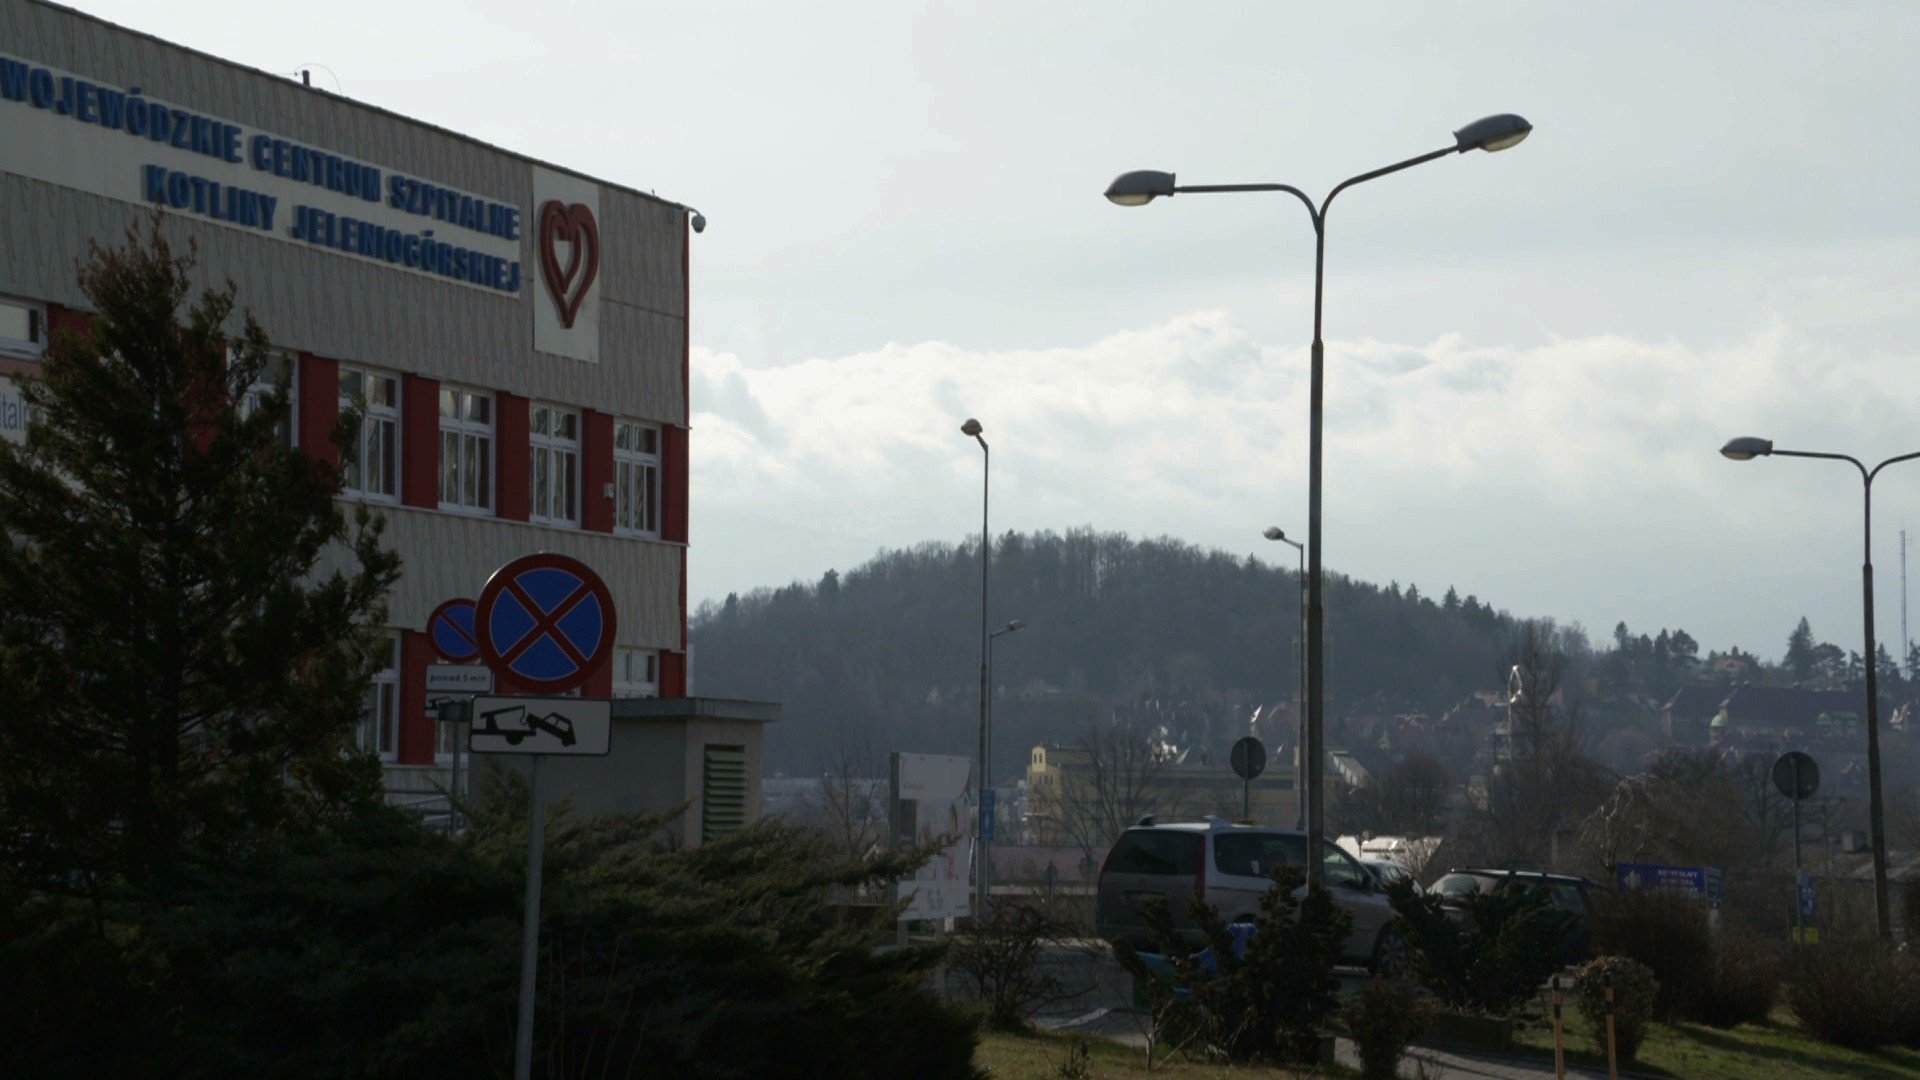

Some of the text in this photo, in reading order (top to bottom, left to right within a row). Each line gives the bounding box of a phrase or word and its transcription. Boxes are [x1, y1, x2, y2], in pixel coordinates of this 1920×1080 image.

[0, 57, 520, 241] WOJEWÓDZKIE CENTRUM SZPITALNE
[144, 164, 520, 292] KOTLINY JELENIOGÓRSKIEJ
[430, 674, 487, 683] ponad 5 min
